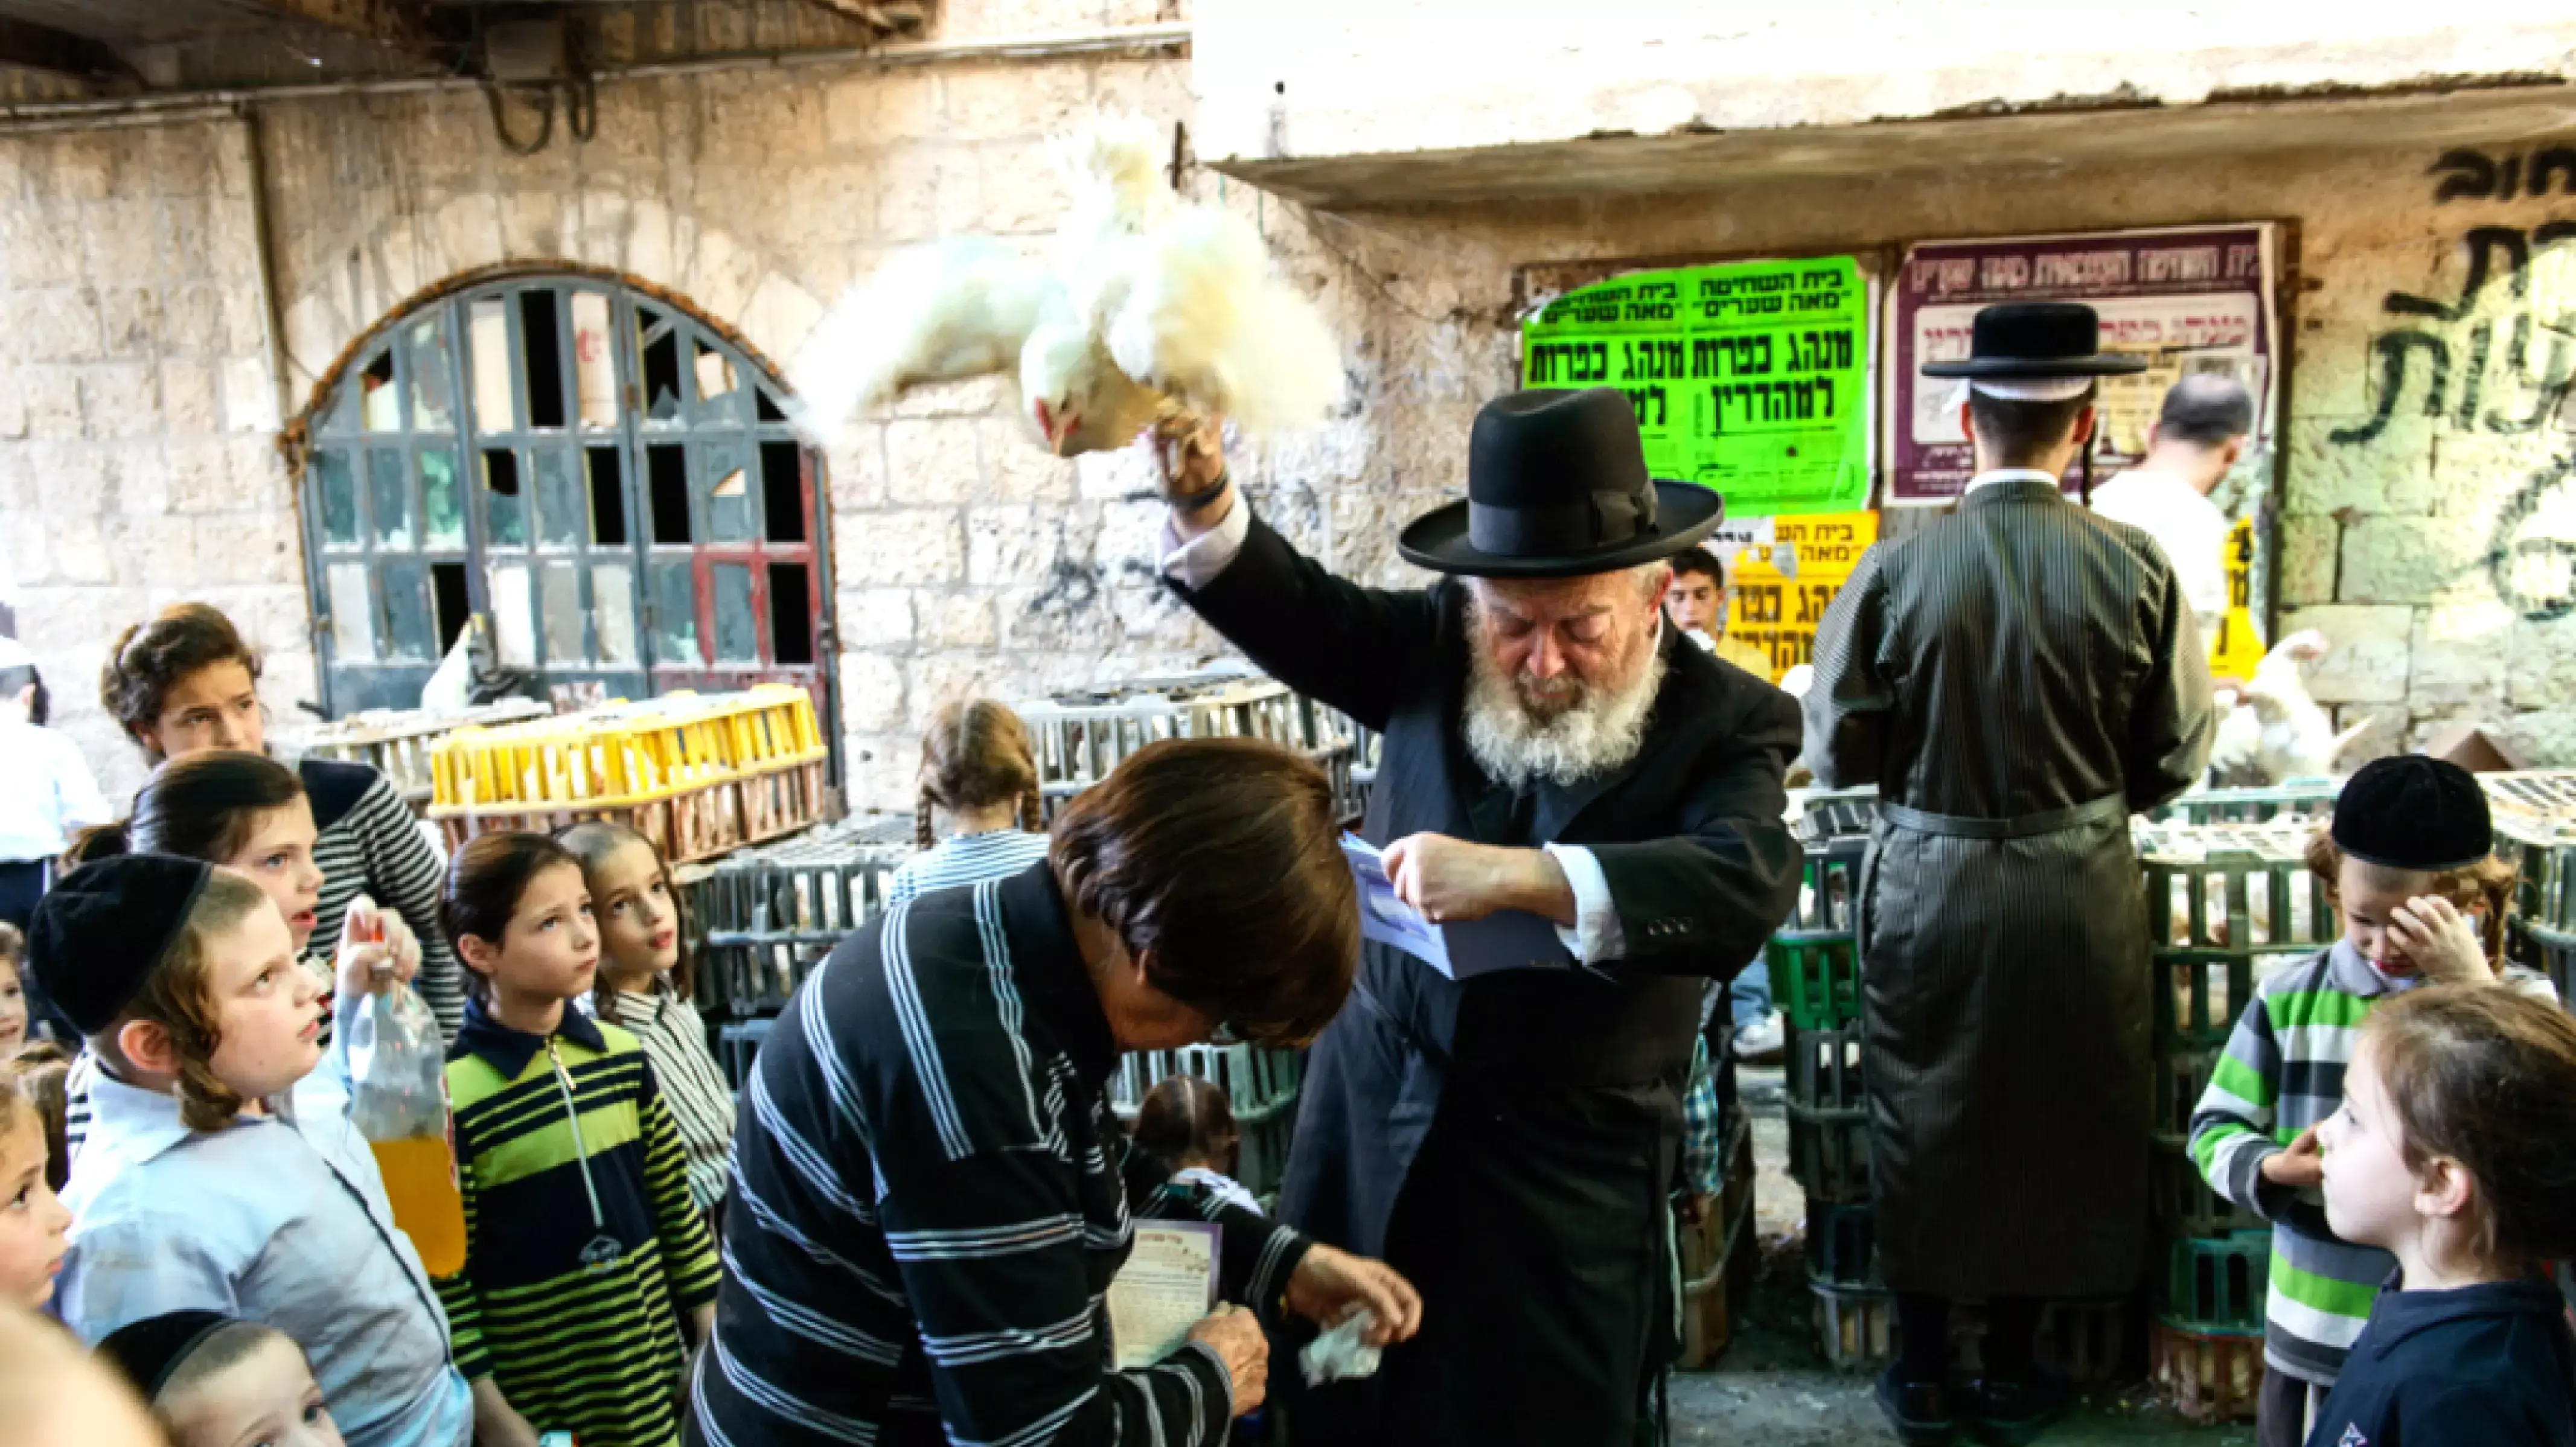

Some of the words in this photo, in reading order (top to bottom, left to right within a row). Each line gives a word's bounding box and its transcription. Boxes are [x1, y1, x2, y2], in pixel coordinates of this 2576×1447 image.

[1637, 281, 1676, 299] בית
[1700, 273, 1794, 296] השחיטה
[1803, 268, 1843, 289] בית
[1530, 343, 1608, 383] כפרות
[1622, 340, 1684, 380] מנהג
[1692, 333, 1772, 379] כפרות
[1786, 330, 1853, 372] מנהג
[1628, 383, 1666, 426] למ
[1711, 373, 1834, 439] למהדרין
[1814, 524, 1853, 541] בית
